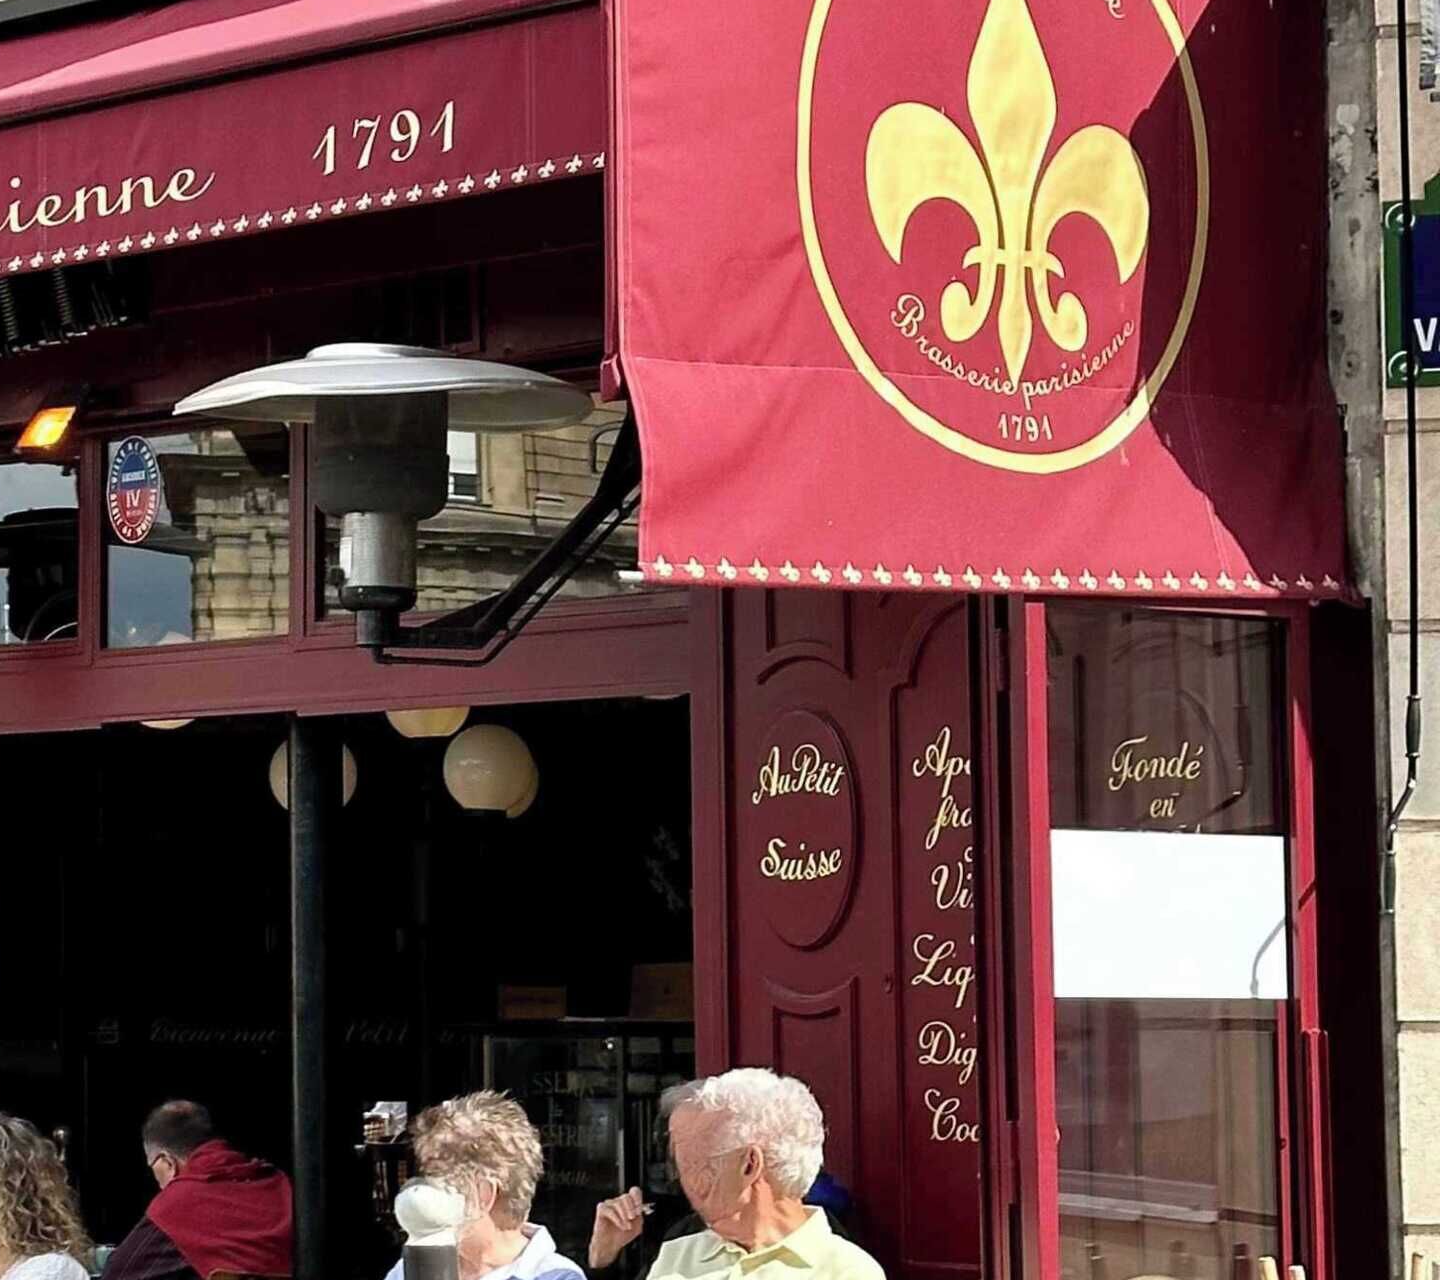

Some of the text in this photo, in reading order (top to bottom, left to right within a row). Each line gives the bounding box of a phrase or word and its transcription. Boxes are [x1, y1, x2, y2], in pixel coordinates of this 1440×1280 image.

[311, 99, 455, 176] 1791
[890, 293, 1136, 410] Brasserie parisienne
[1412, 317, 1440, 352] V
[997, 411, 1054, 442] 1791
[752, 743, 846, 805] Au Petit
[1108, 735, 1205, 791] Fondé
[1149, 796, 1178, 818] en
[760, 837, 843, 881] Suisse
[930, 861, 975, 910] Vi
